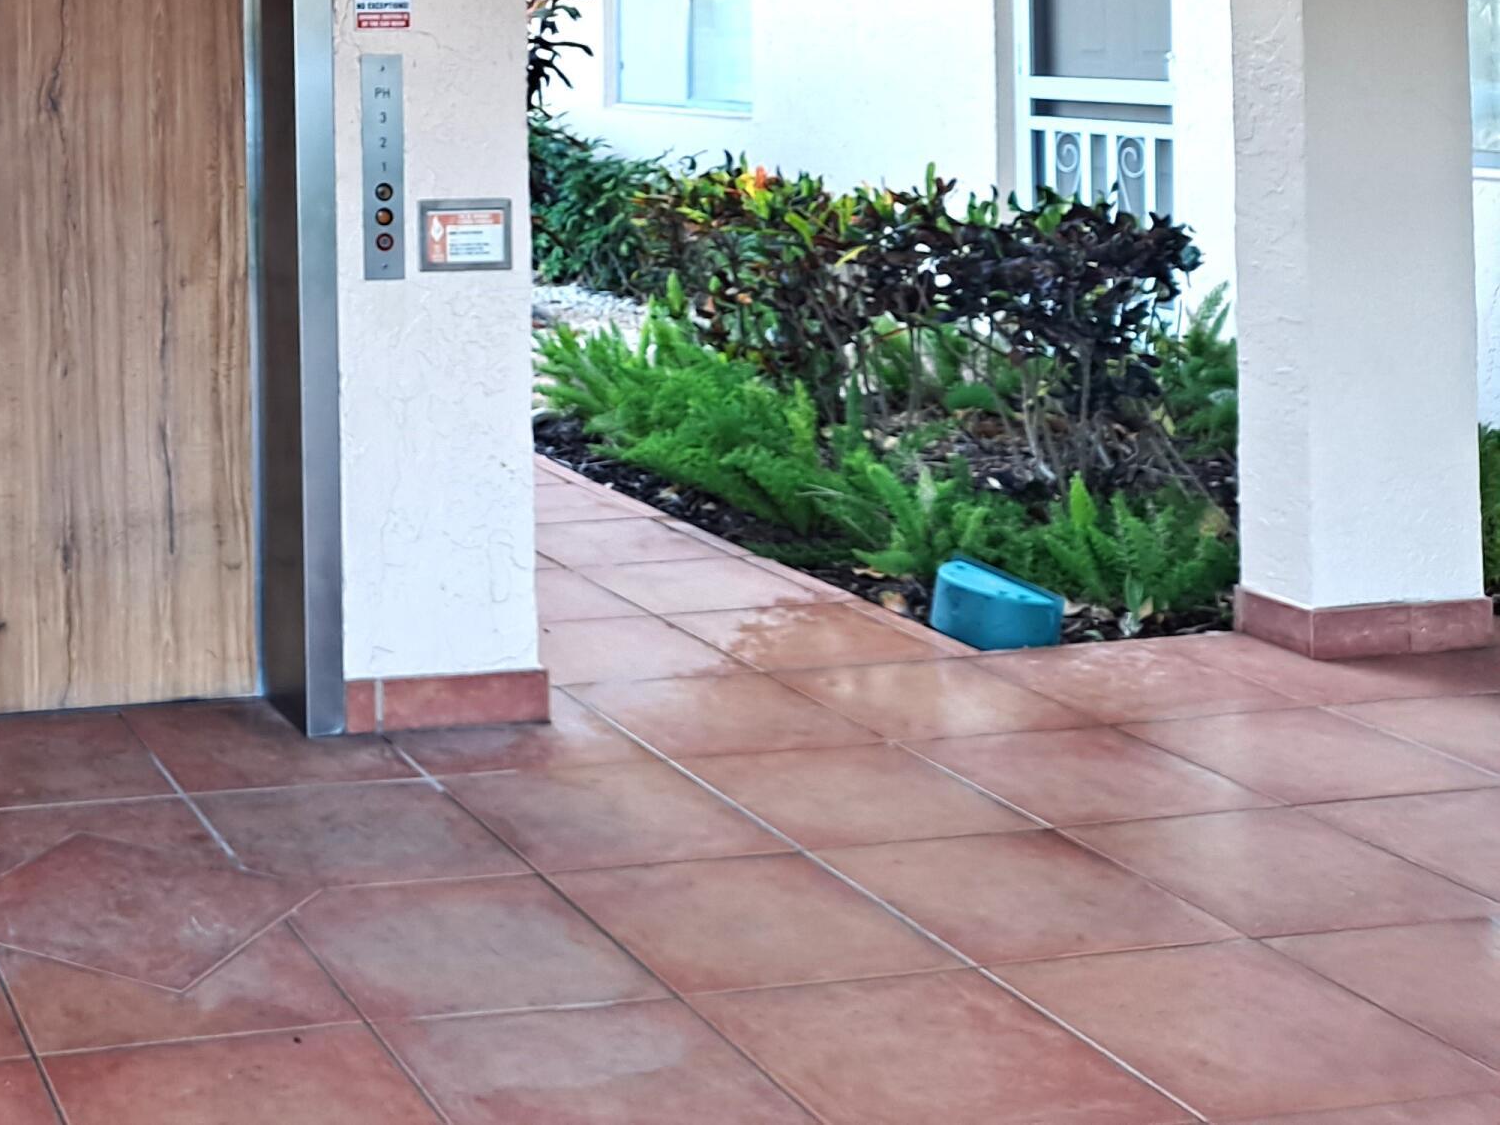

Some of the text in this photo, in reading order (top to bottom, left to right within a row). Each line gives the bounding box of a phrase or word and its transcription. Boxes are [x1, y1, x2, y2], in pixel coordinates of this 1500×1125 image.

[374, 87, 391, 99] PH
[380, 112, 387, 124] 3
[380, 137, 387, 148] 2
